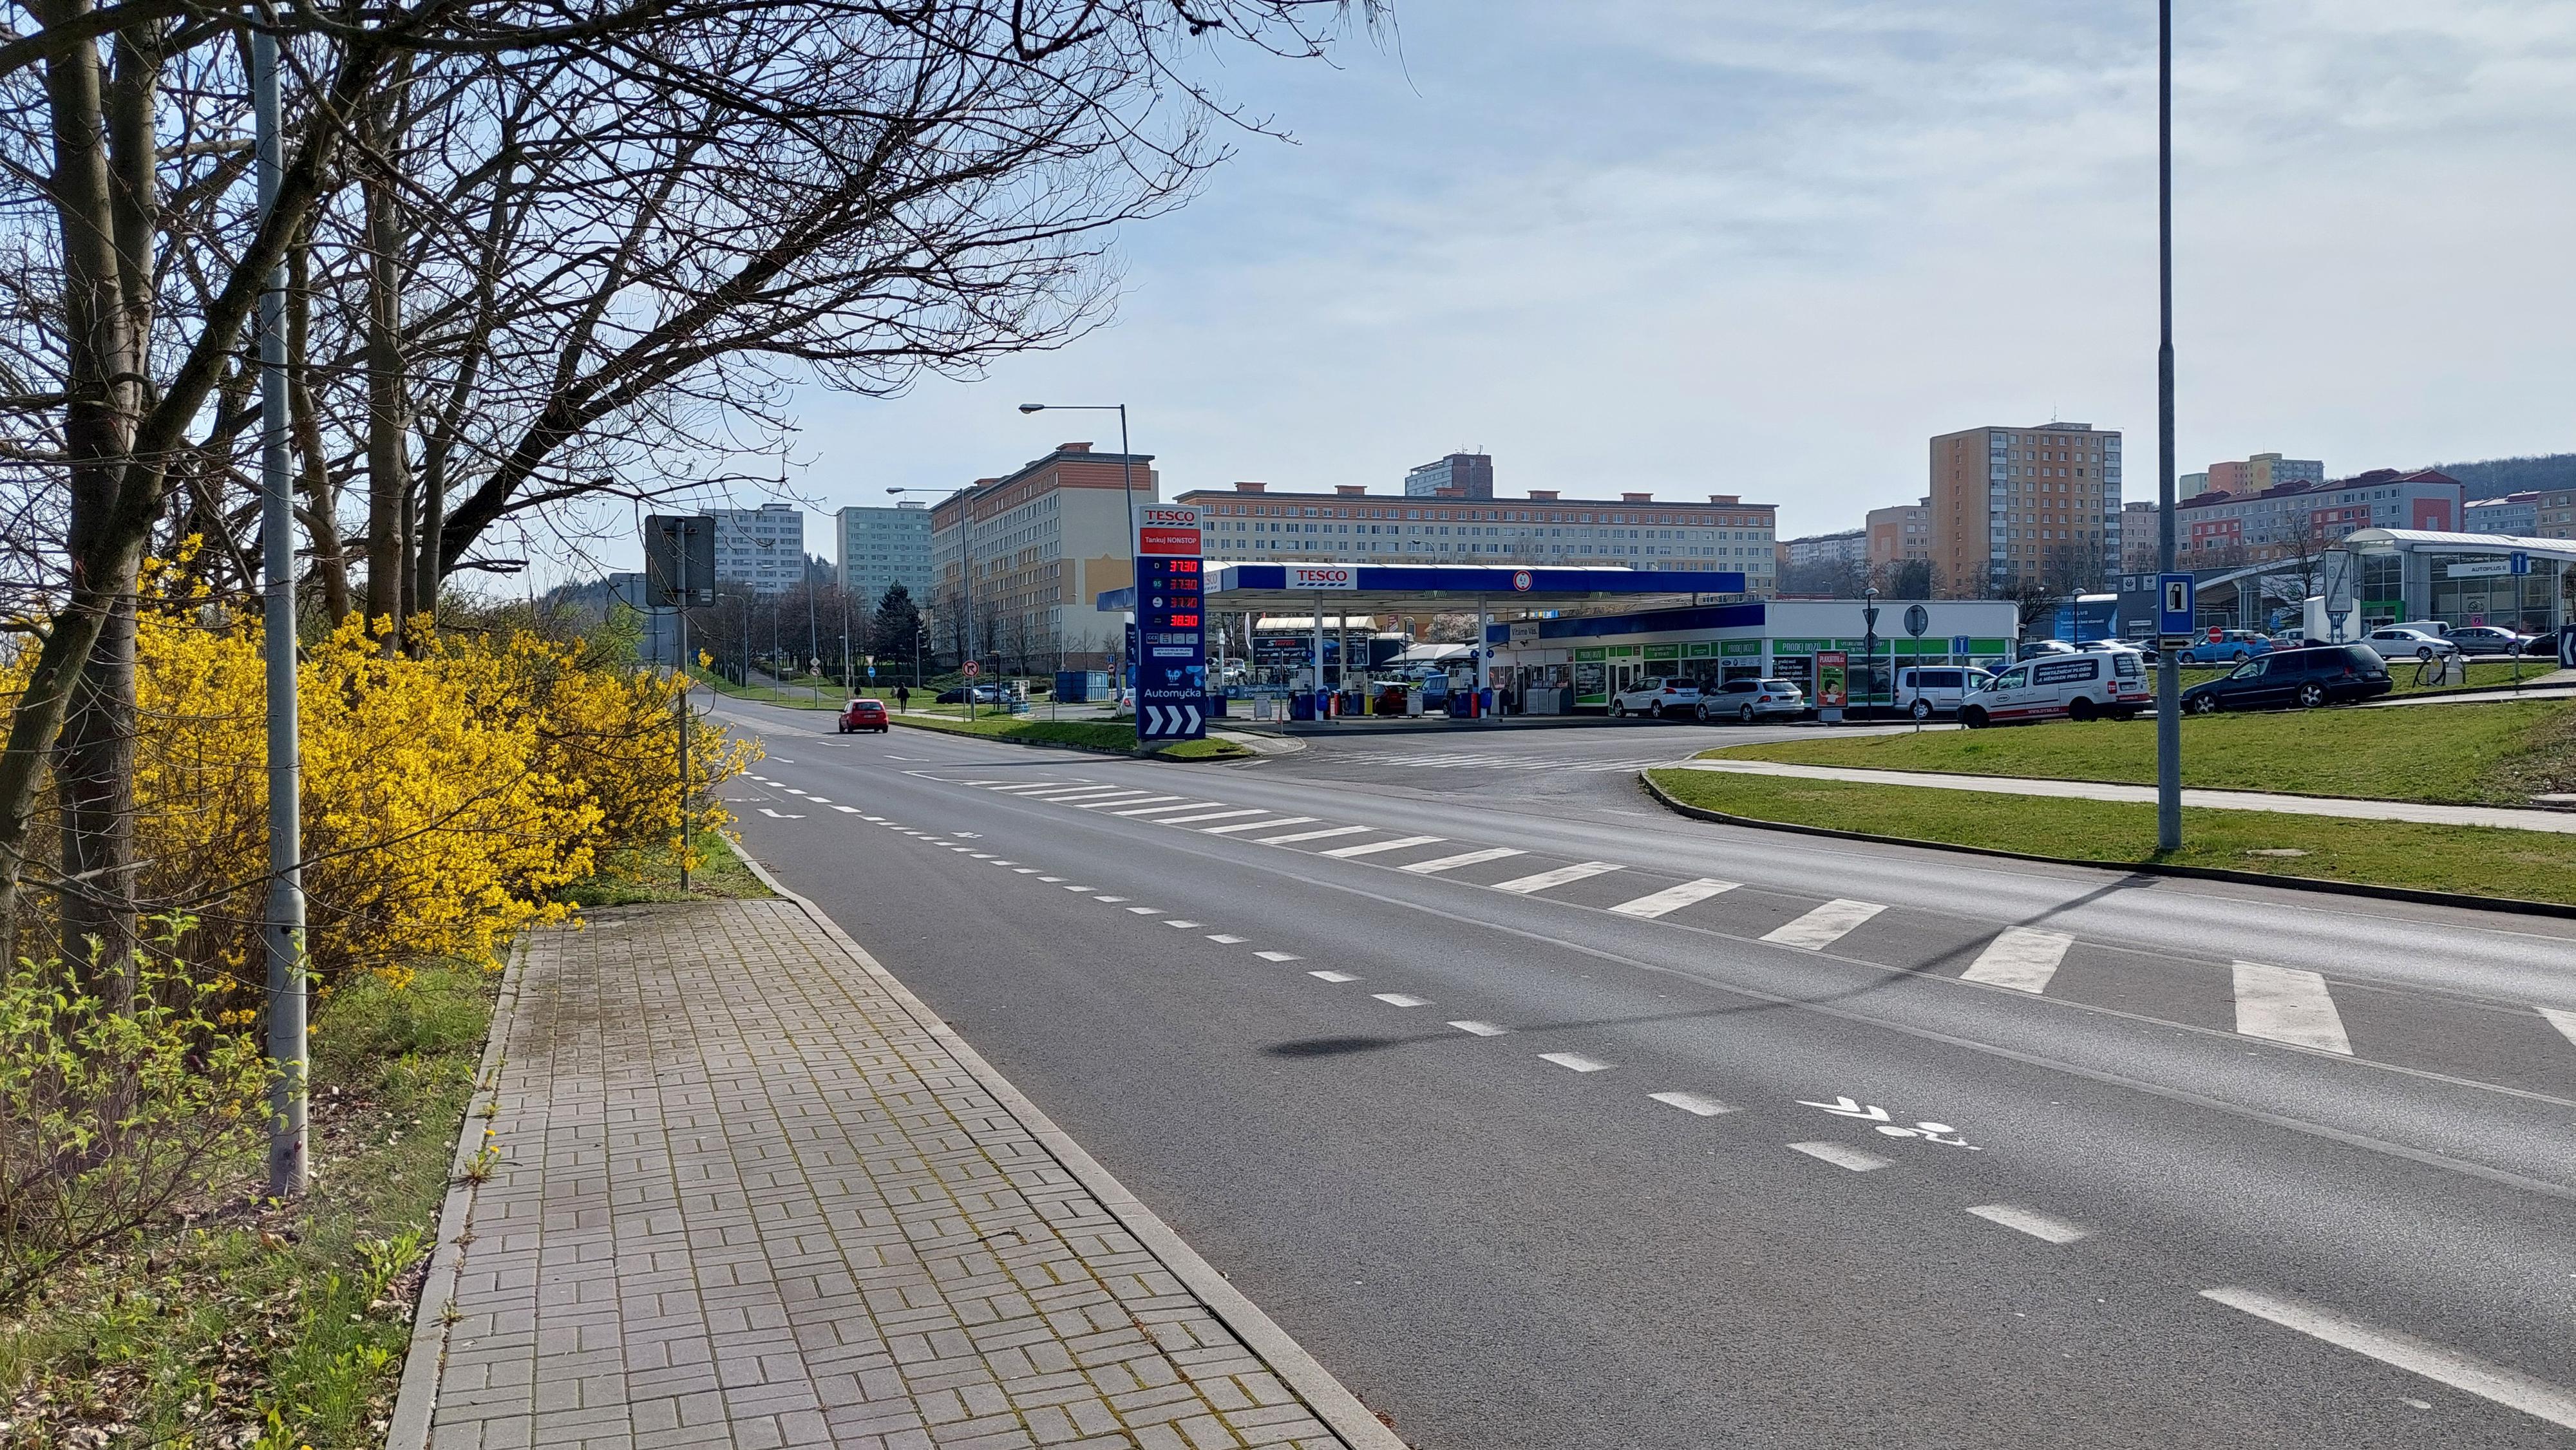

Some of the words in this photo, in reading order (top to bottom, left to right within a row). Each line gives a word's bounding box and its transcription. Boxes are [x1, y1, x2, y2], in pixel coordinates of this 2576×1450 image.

[1145, 511, 1195, 522] TESCO
[1296, 570, 1347, 581] TESCO
[1783, 643, 1804, 653] PRODEJ
[1144, 688, 1201, 699] Automyčka
